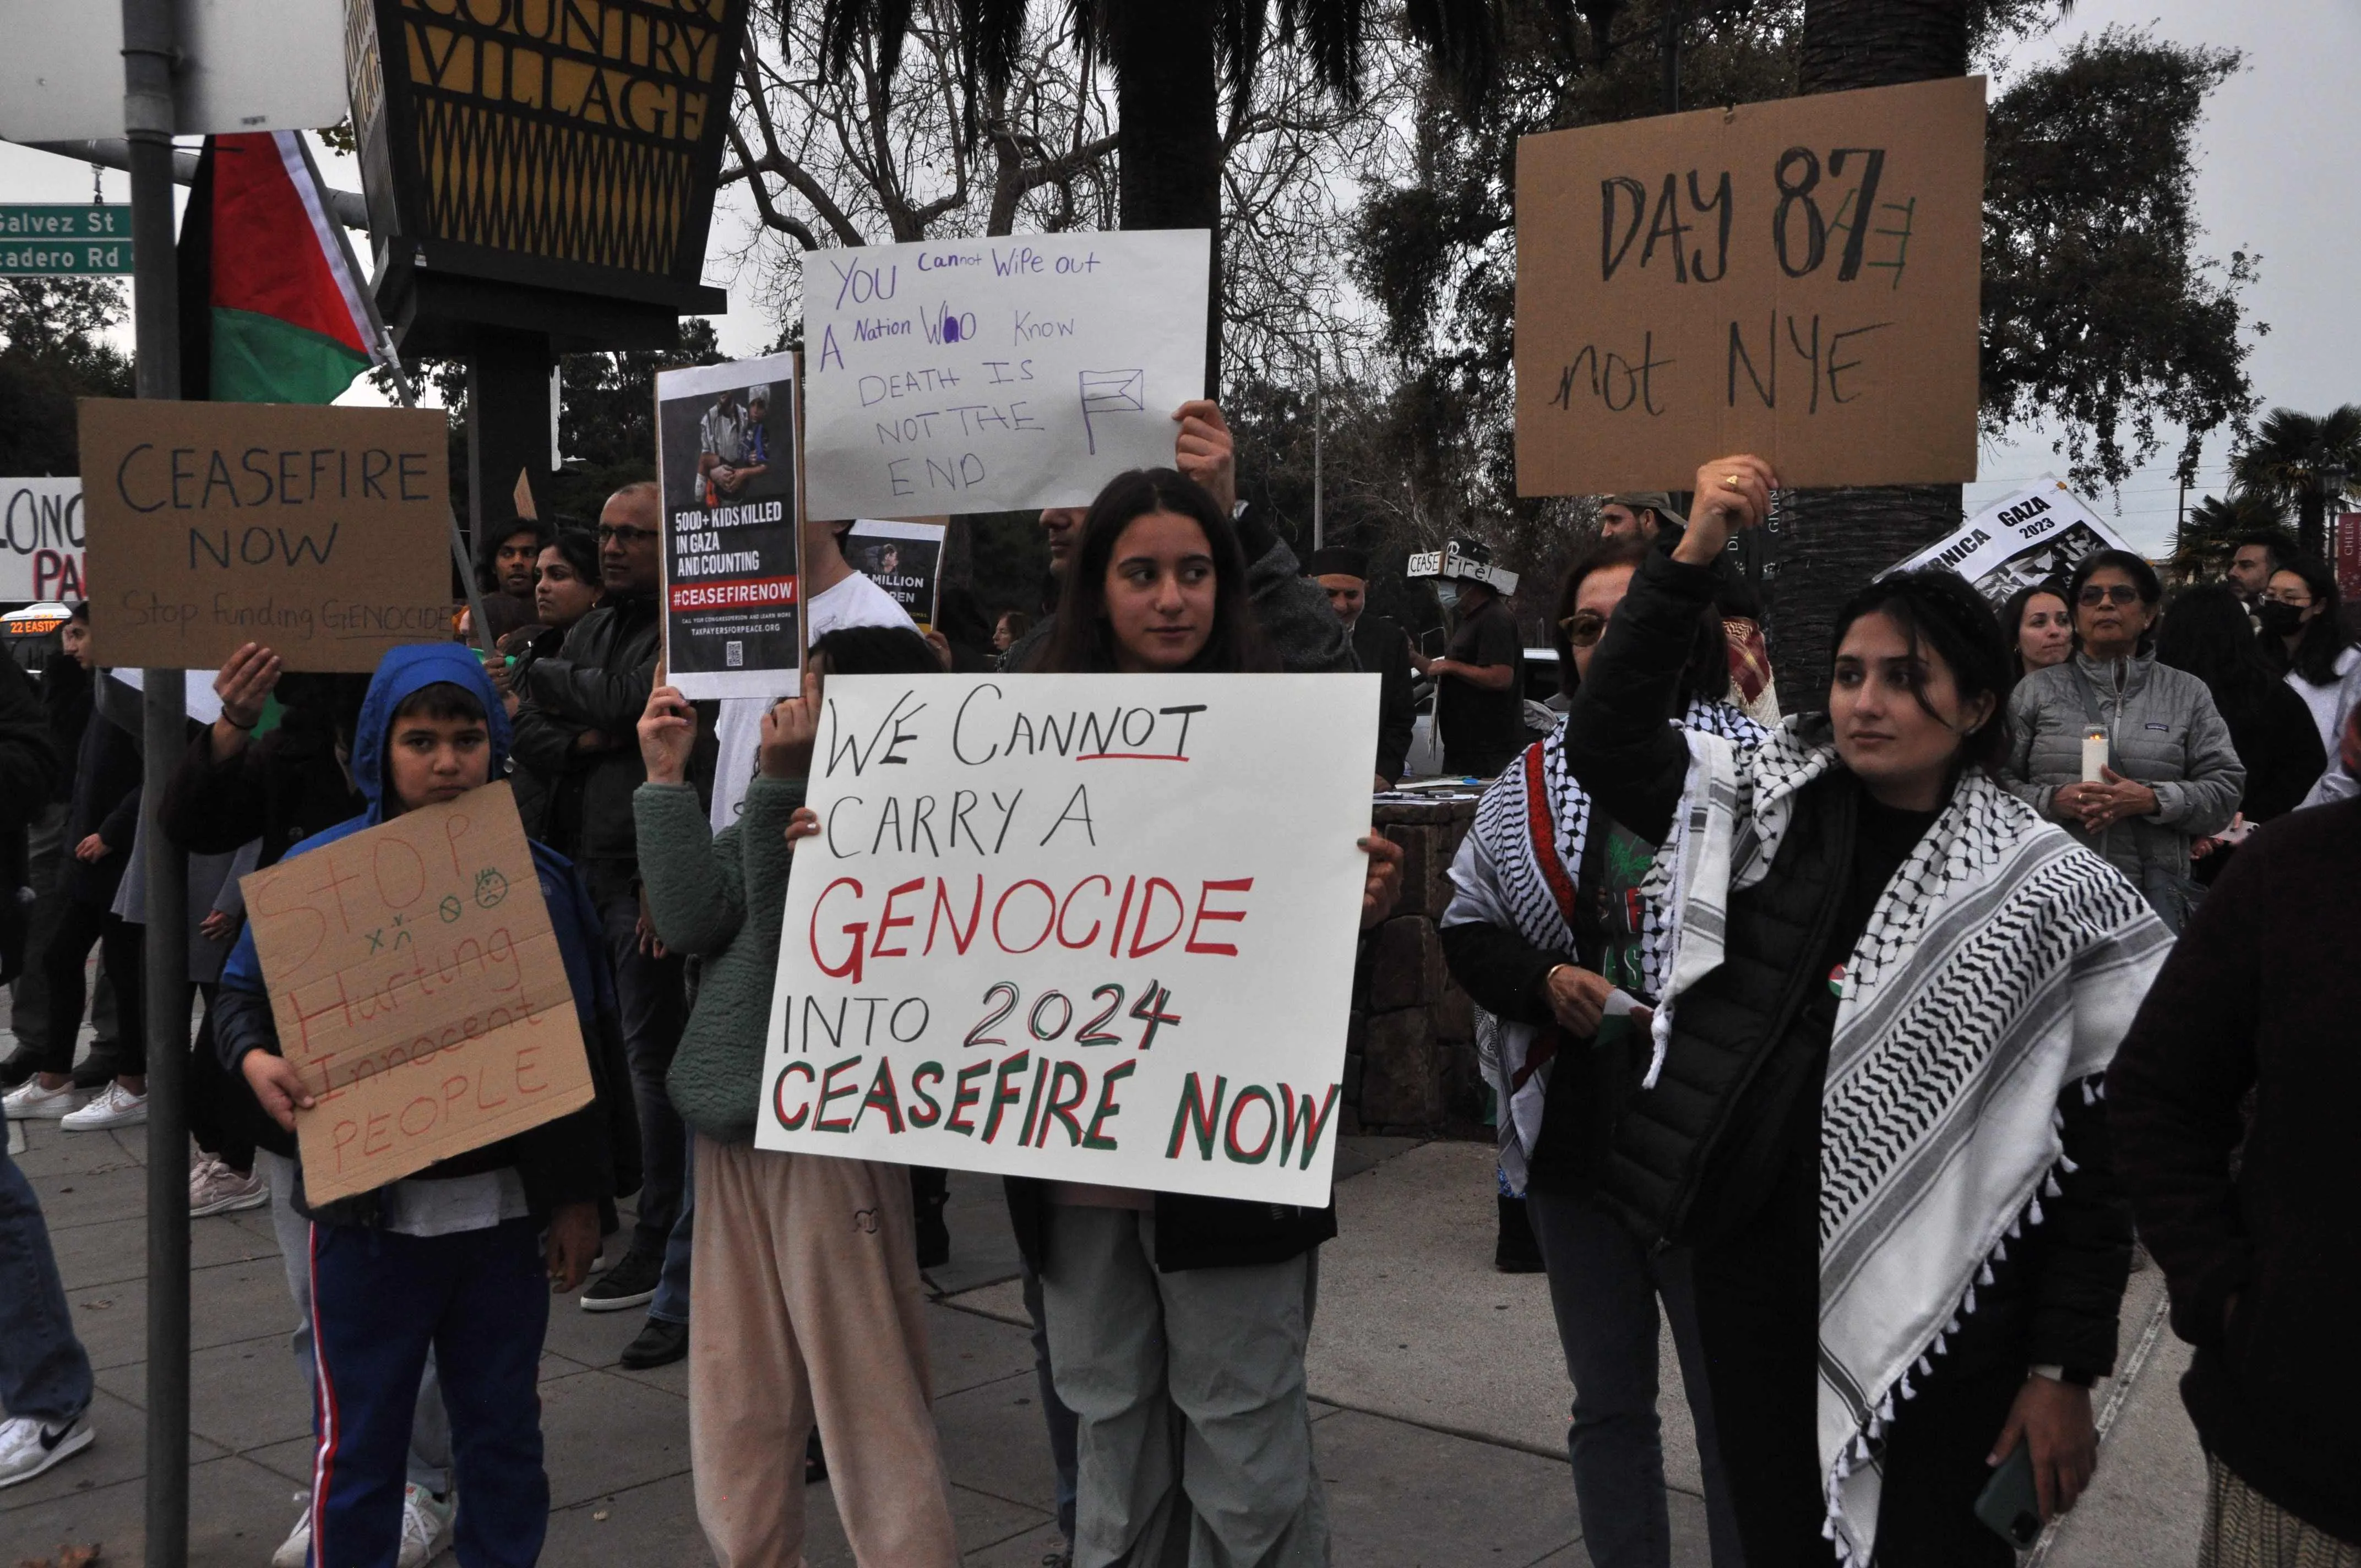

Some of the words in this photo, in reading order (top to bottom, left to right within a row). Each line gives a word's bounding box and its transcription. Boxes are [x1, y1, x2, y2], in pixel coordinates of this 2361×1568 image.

[412, 22, 707, 142] VILLAGE
[88, 213, 114, 232] St
[1601, 168, 1733, 283] DAY
[1773, 146, 1885, 282] 87
[0, 247, 74, 267] adero
[88, 247, 118, 267] Rd
[830, 257, 896, 309] YOU
[918, 253, 982, 271] Cannot
[1056, 252, 1100, 273] out
[820, 324, 844, 372] A
[854, 319, 911, 341] Nation
[1015, 310, 1074, 346] Know
[1548, 331, 1676, 416] not
[1728, 309, 1895, 415] NYE
[858, 368, 960, 406] DEATH
[982, 360, 1034, 384] IS
[876, 412, 939, 444] NOT
[946, 401, 1045, 435] THE
[117, 444, 429, 513] CEASEFIRE
[888, 453, 985, 496] END
[676, 511, 709, 531] 5000+
[711, 507, 739, 527] KIDS
[741, 502, 781, 524] KILLED
[1768, 489, 1779, 532] GIVIN
[1997, 496, 2052, 527] GAZA
[2019, 517, 2055, 540] 2023
[189, 522, 338, 569] NOW
[677, 534, 687, 554] IN
[690, 531, 720, 552] GAZA
[678, 557, 699, 576] AND
[701, 551, 759, 575] COUNTING
[1411, 554, 1439, 573] CEASE
[674, 582, 792, 606] #CEASEFIRENOW
[872, 575, 923, 588] MILLION
[10, 622, 23, 633] 22
[123, 590, 198, 636] Stop
[214, 593, 313, 639] funding
[322, 600, 453, 633] GENOCIDE
[692, 624, 780, 635] TAXPAYERSFORPEACE.ORG
[826, 689, 927, 778] WE
[953, 684, 1207, 765] CANNOT
[828, 788, 1024, 858] CARRY
[1040, 784, 1095, 846] A
[256, 814, 470, 979] STOP
[809, 873, 1255, 984] GENOCIDE
[288, 927, 520, 1053] Hurting
[784, 997, 929, 1053] INTO
[964, 979, 1181, 1050] 2024
[309, 988, 542, 1104] Innocent
[332, 1046, 547, 1173] PEOPLE
[773, 1049, 1137, 1151] CEASEFIRE
[1166, 1071, 1342, 1170] NOW
